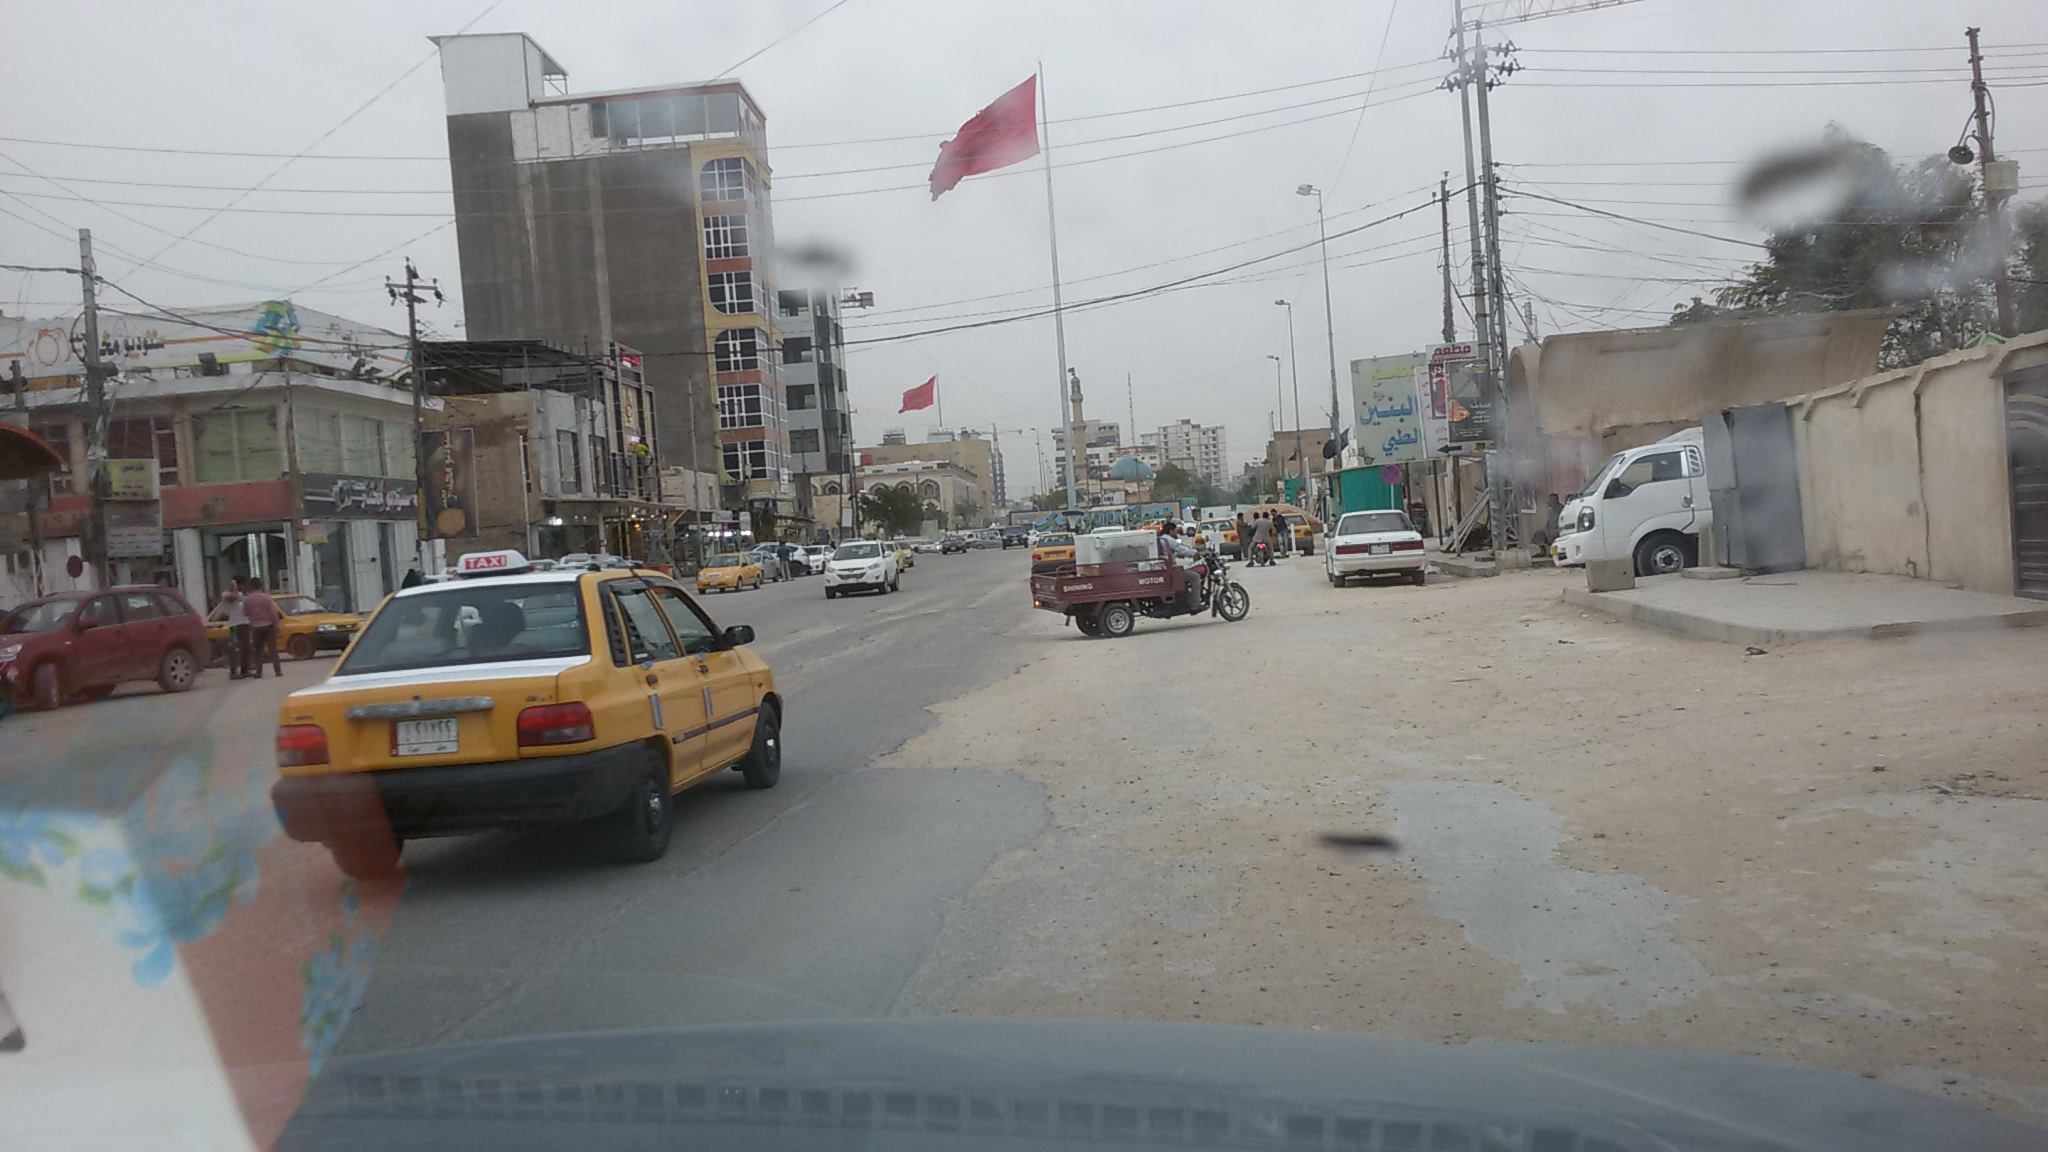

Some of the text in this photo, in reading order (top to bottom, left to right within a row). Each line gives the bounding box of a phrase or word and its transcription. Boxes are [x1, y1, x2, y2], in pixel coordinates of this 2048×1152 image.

[1432, 344, 1471, 358] مطعم
[467, 556, 506, 569] TAXI
[1063, 583, 1094, 592] SHINING
[1138, 576, 1165, 585] MOTOR
